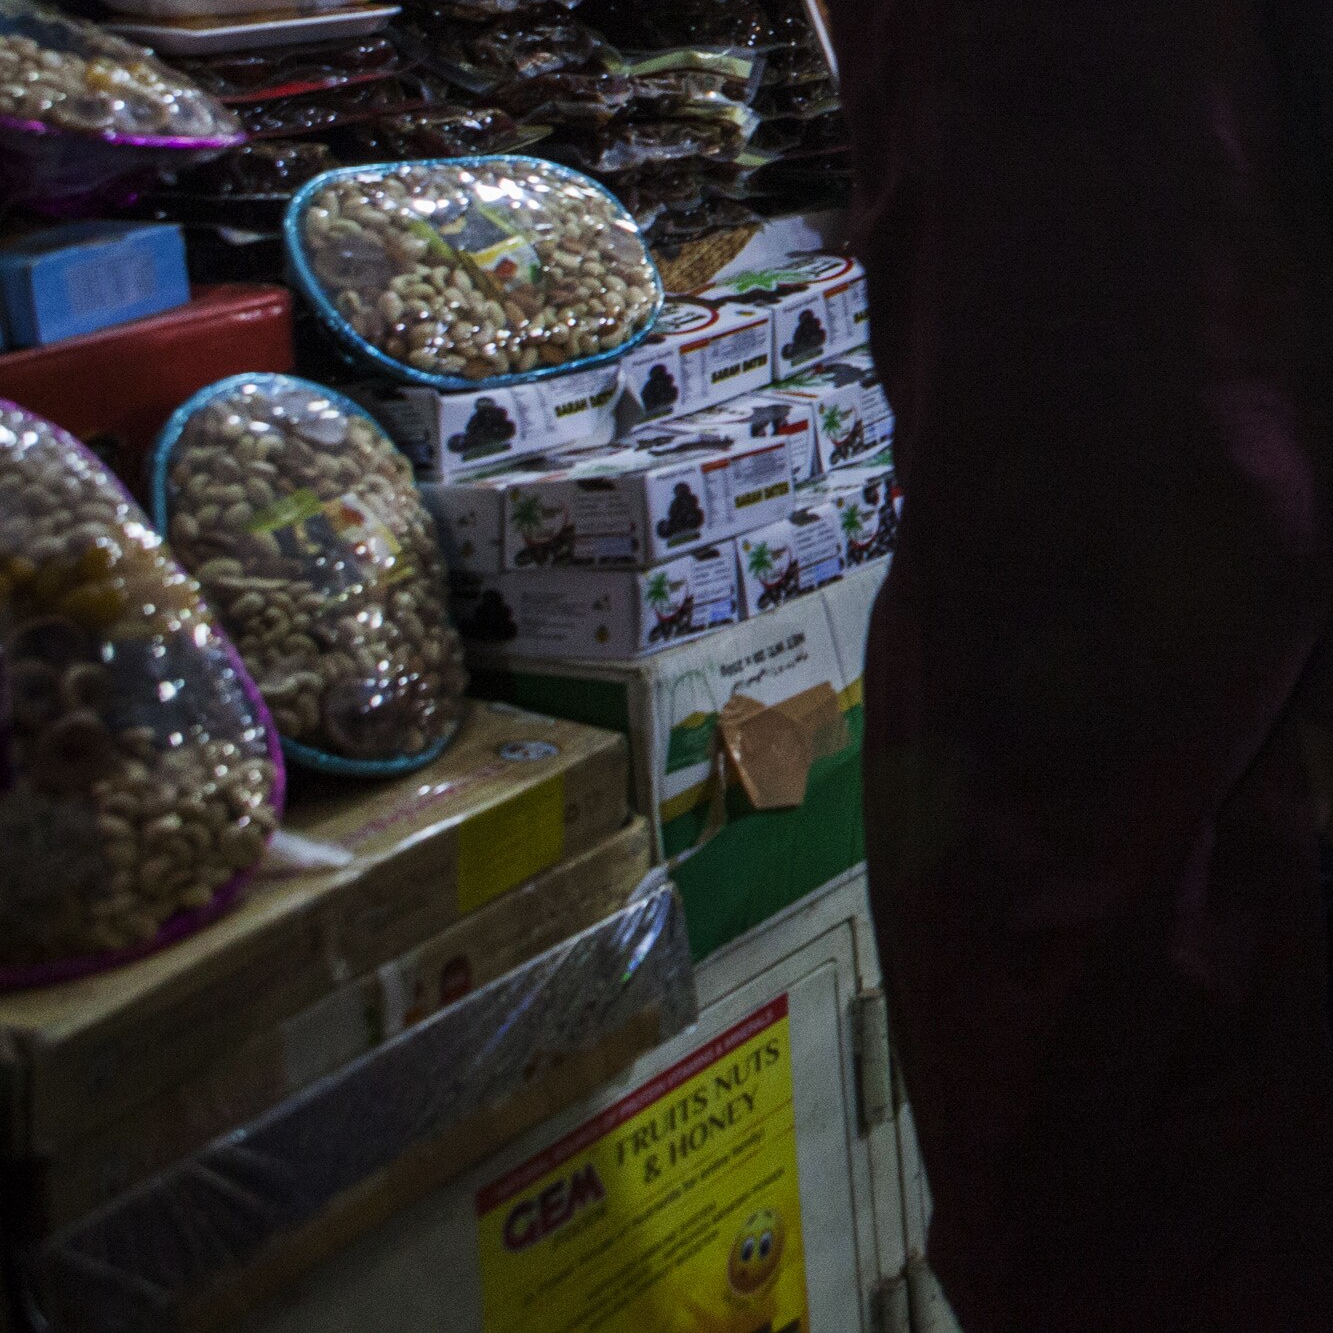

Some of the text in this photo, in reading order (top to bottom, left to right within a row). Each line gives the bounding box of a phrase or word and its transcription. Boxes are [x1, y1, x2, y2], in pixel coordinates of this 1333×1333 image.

[614, 1037, 781, 1167] FRUITS NUTS
[667, 1088, 760, 1167] HONEY
[502, 1162, 607, 1256] GEM
